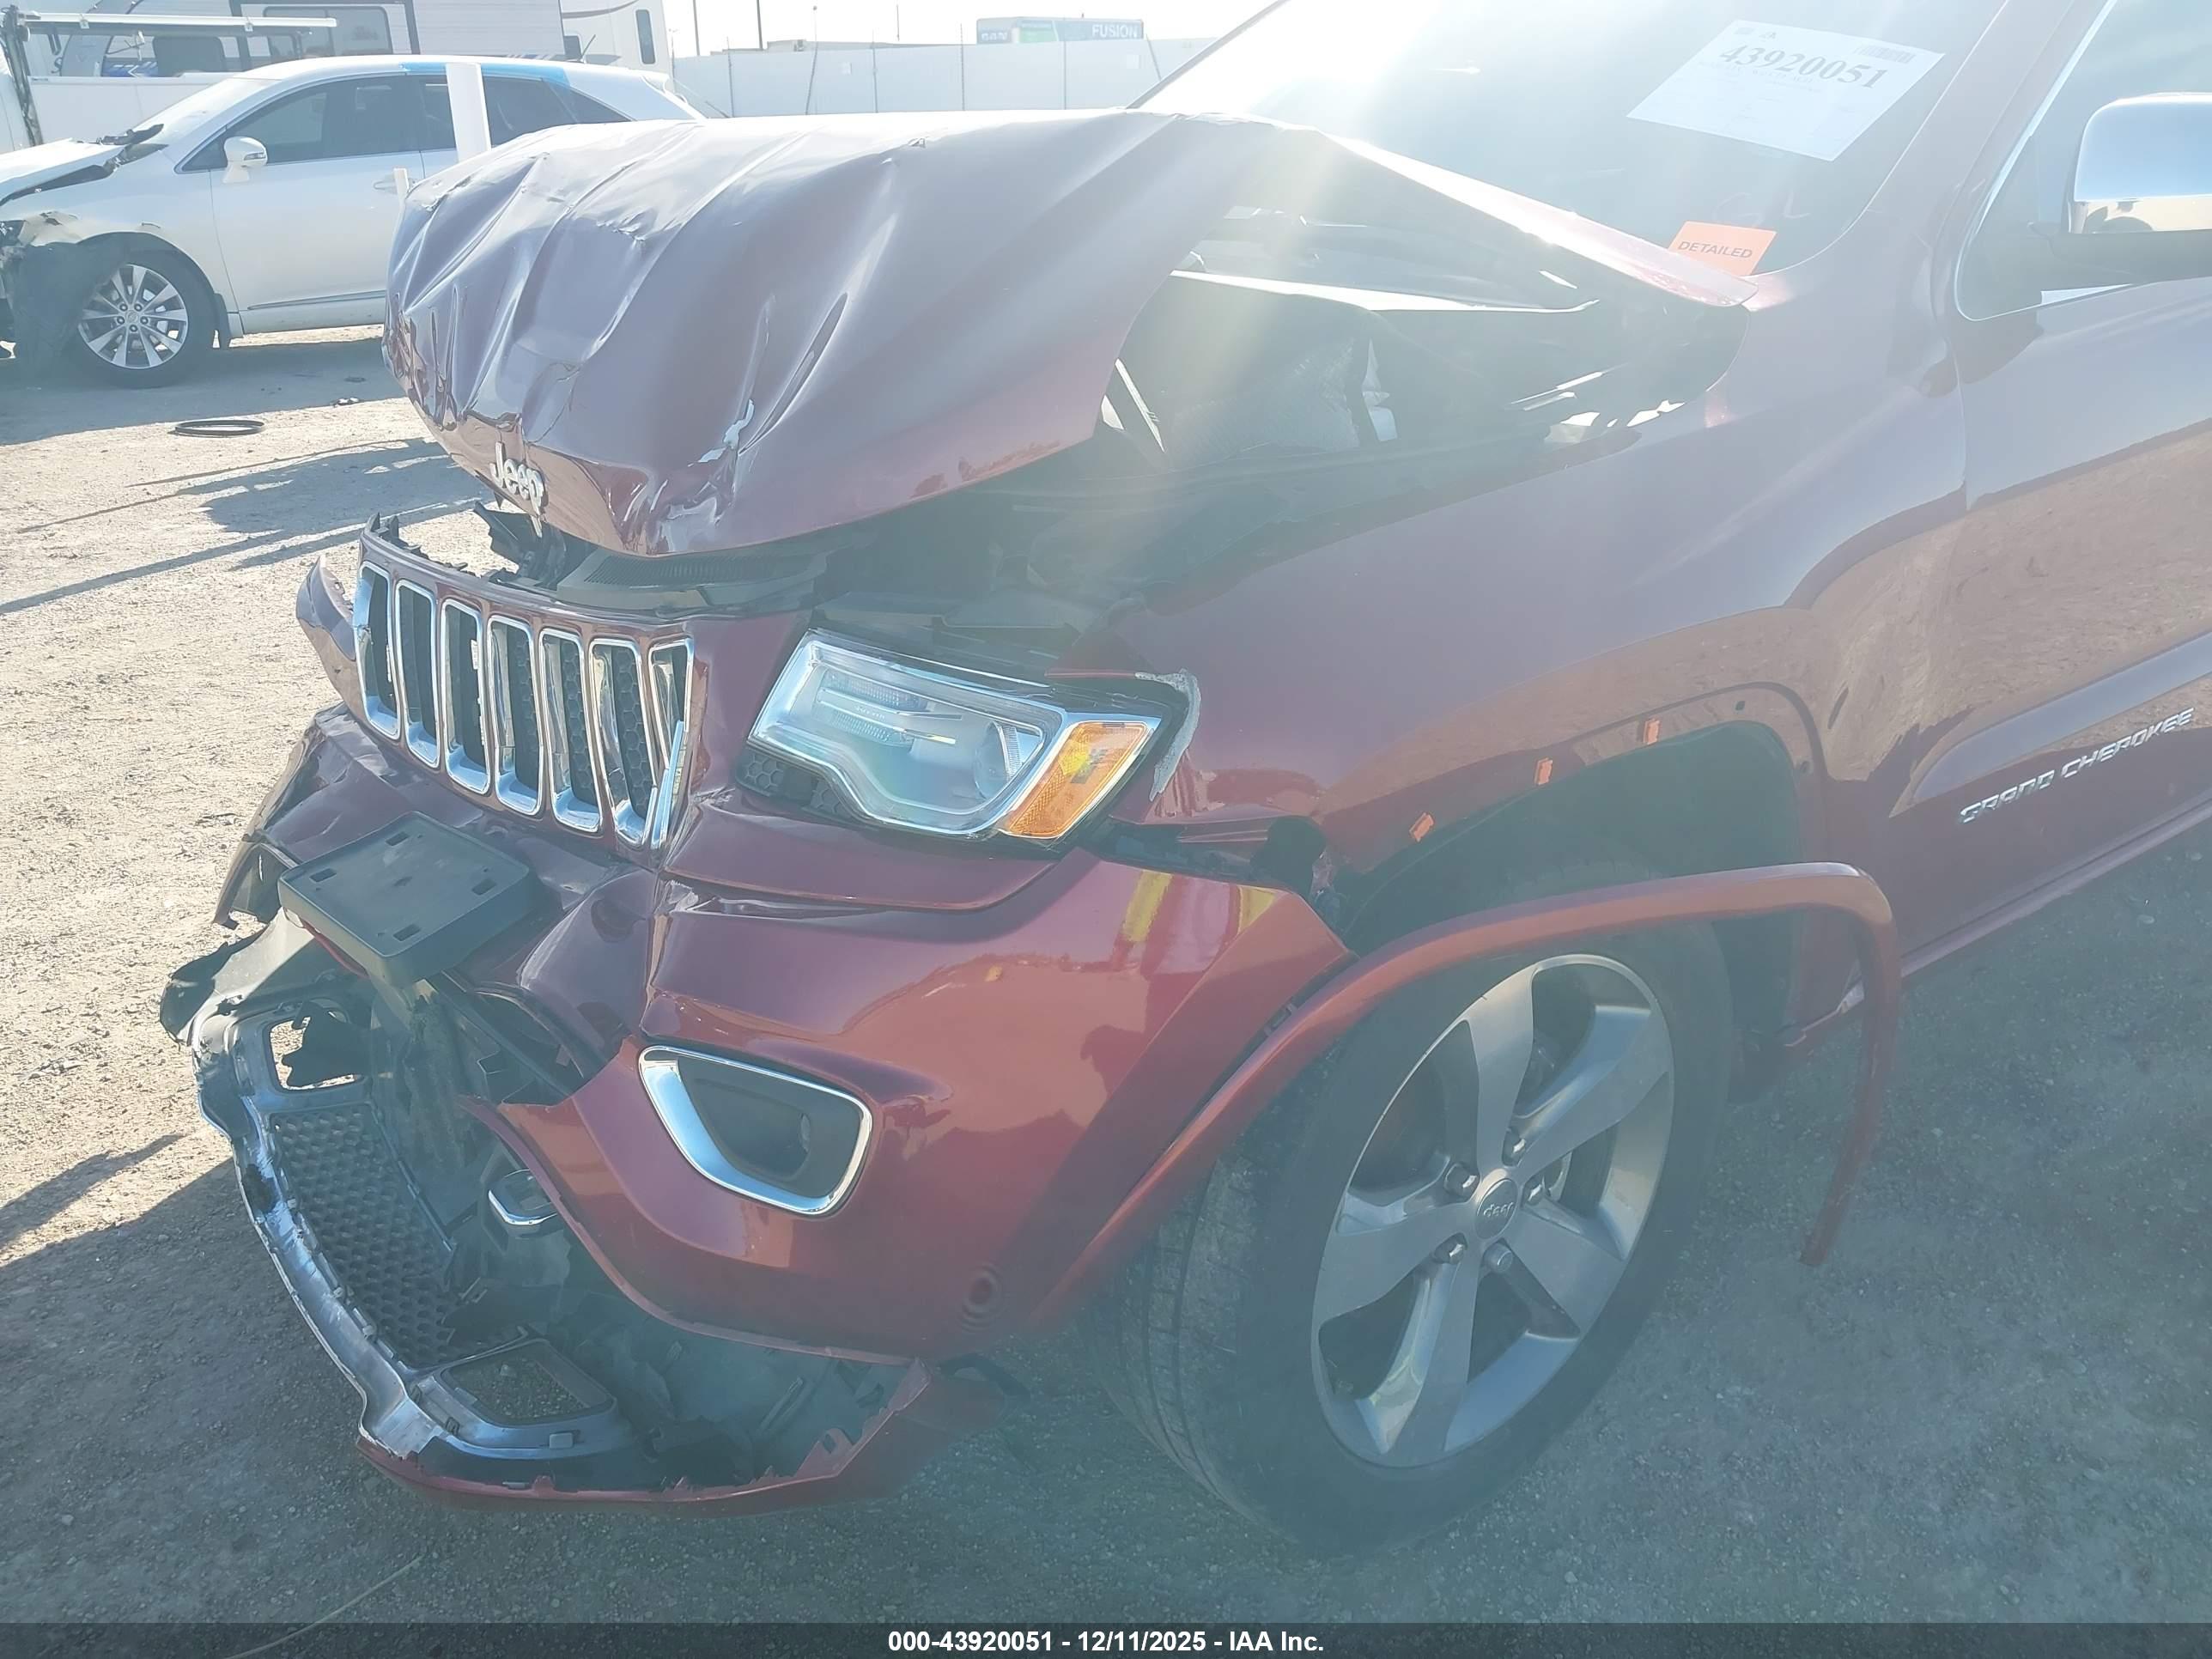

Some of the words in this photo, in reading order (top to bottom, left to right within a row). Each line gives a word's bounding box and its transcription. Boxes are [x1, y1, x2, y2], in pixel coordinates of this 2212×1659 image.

[1091, 23, 1138, 39] FUSION
[1720, 45, 1889, 89] 43920051
[1678, 240, 1753, 258] DETAILED
[489, 441, 544, 526] Jeep
[1960, 769, 2056, 823] GRAND
[2060, 707, 2196, 778] CHEROKEE
